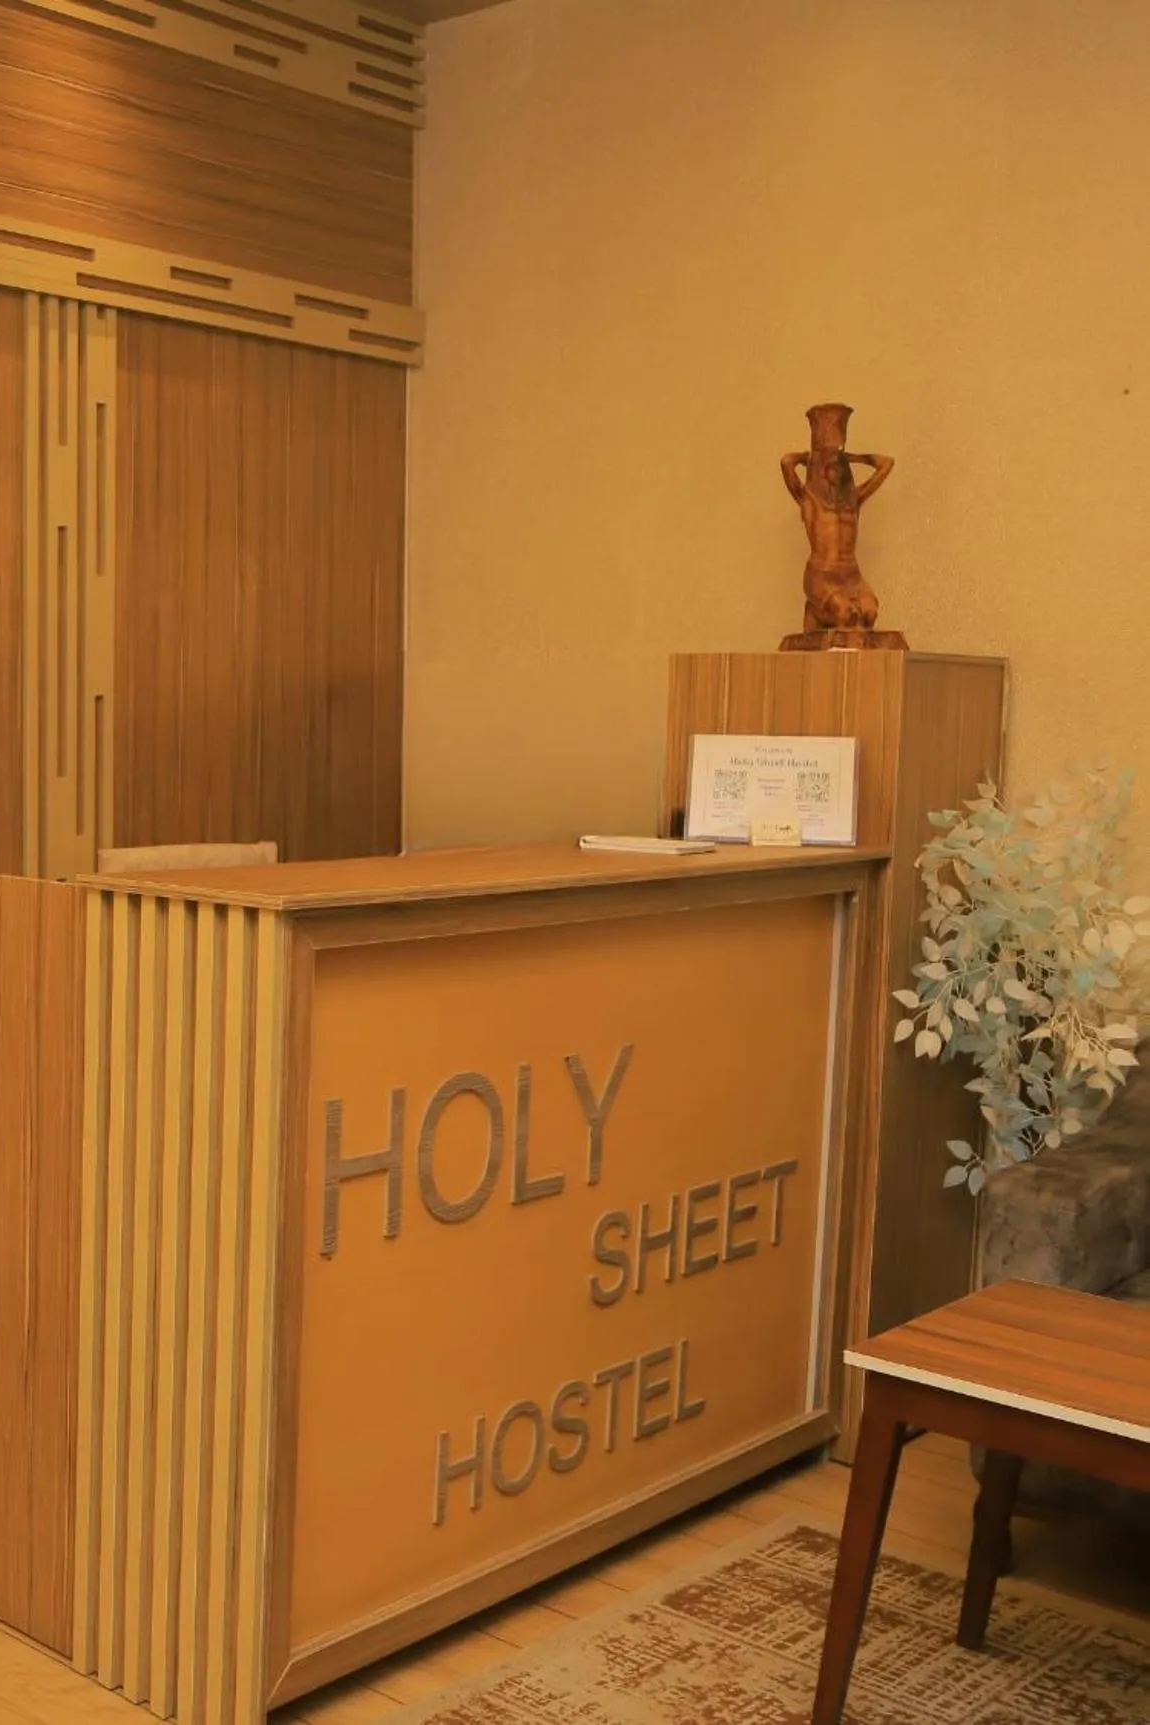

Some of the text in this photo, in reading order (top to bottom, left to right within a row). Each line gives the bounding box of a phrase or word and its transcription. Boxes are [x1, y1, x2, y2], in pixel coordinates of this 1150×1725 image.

[319, 1043, 634, 1260] HOLY
[589, 1158, 799, 1308] SHEET
[432, 1339, 706, 1526] HOSTEL
